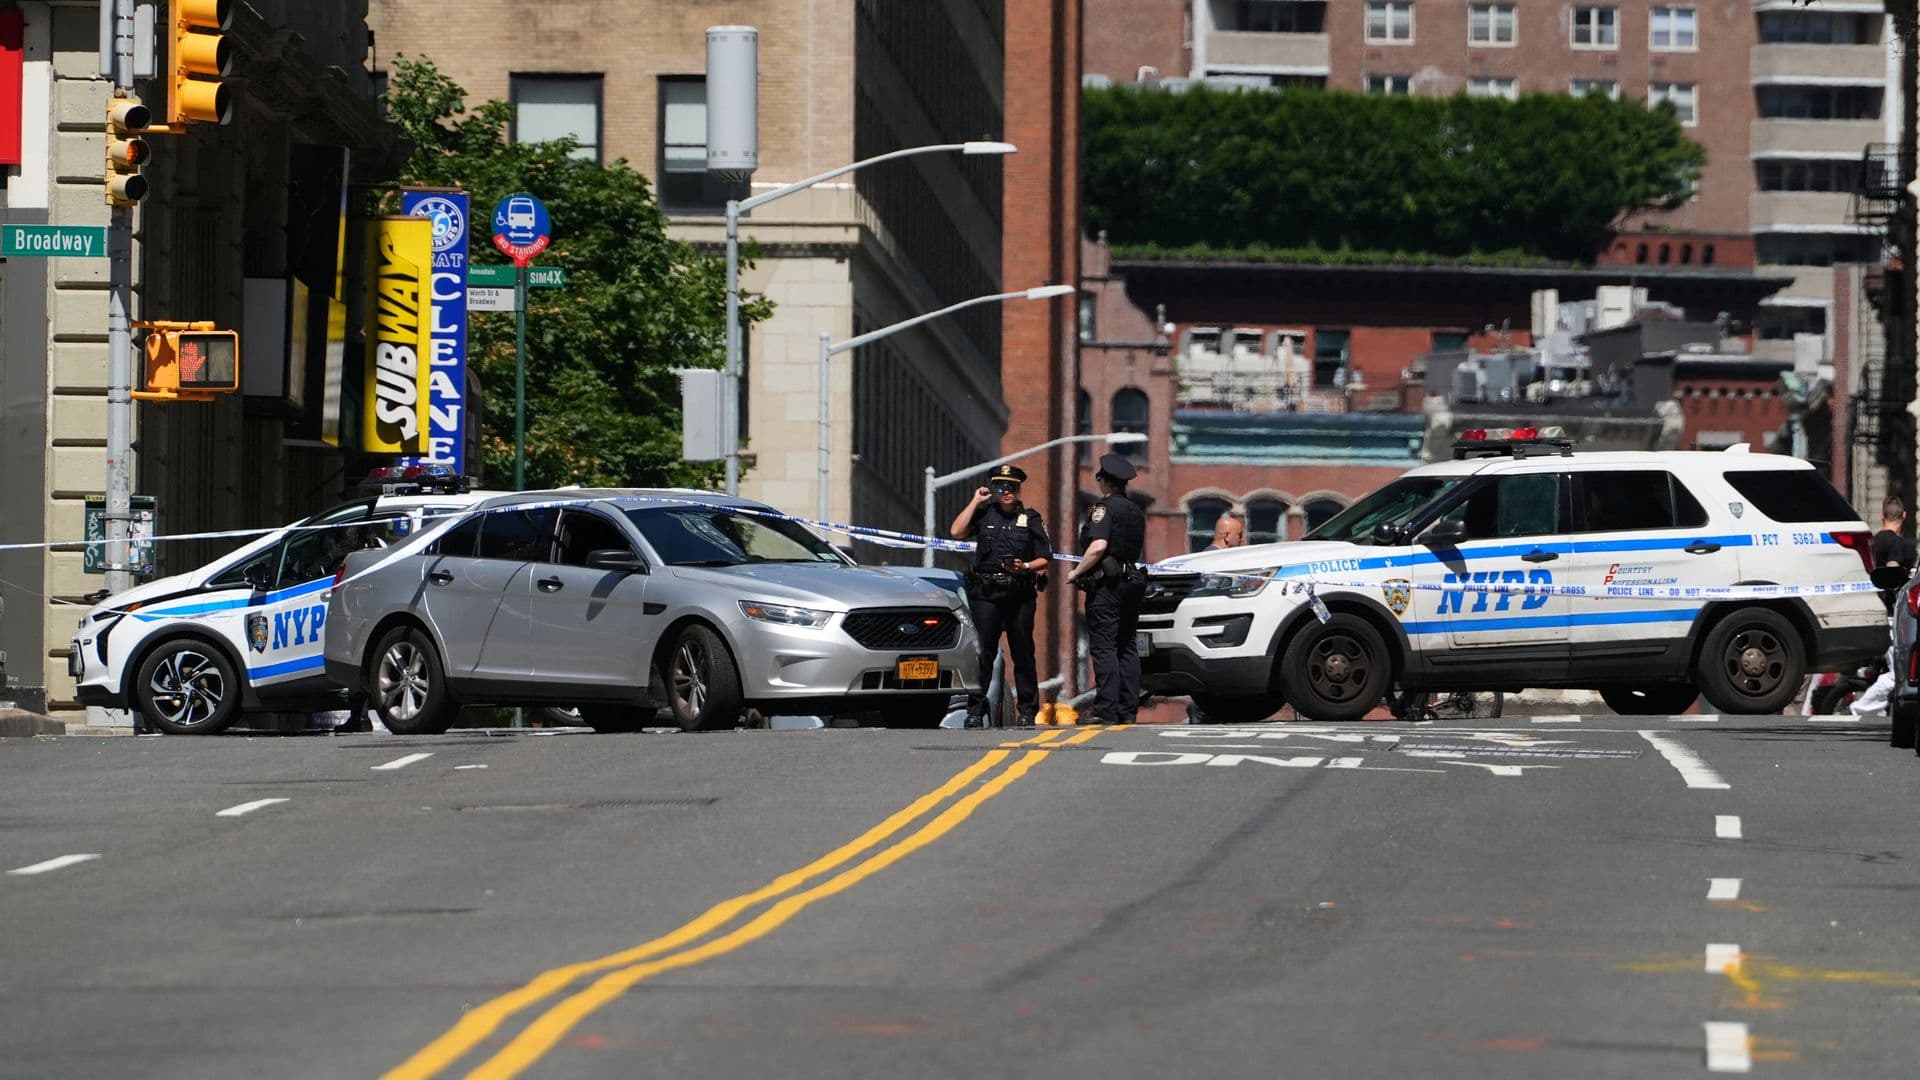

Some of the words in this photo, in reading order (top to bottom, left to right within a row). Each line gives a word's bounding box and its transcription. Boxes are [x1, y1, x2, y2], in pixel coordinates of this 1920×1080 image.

[15, 229, 93, 256] Broadway
[498, 236, 509, 250] NO
[509, 238, 546, 257] STANDING
[530, 270, 562, 284] SIM4X
[376, 232, 418, 441] SUBWAY
[1762, 533, 1779, 546] PCT
[1792, 532, 1815, 545] 5362
[1310, 559, 1358, 574] POLICE
[1437, 569, 1553, 614] NYPD
[1464, 584, 1488, 592] POLICE
[1525, 586, 1535, 594] DO
[1541, 586, 1555, 594] NOT
[1561, 586, 1586, 595] CROSS
[1608, 587, 1633, 596] POLICE
[1639, 587, 1654, 596] LINE
[1669, 588, 1680, 596] DO
[1686, 588, 1700, 597] NOT
[1814, 585, 1825, 593] DO
[1831, 584, 1846, 592] NOT
[272, 604, 326, 650] NYP
[1100, 752, 1564, 776] ONLY
